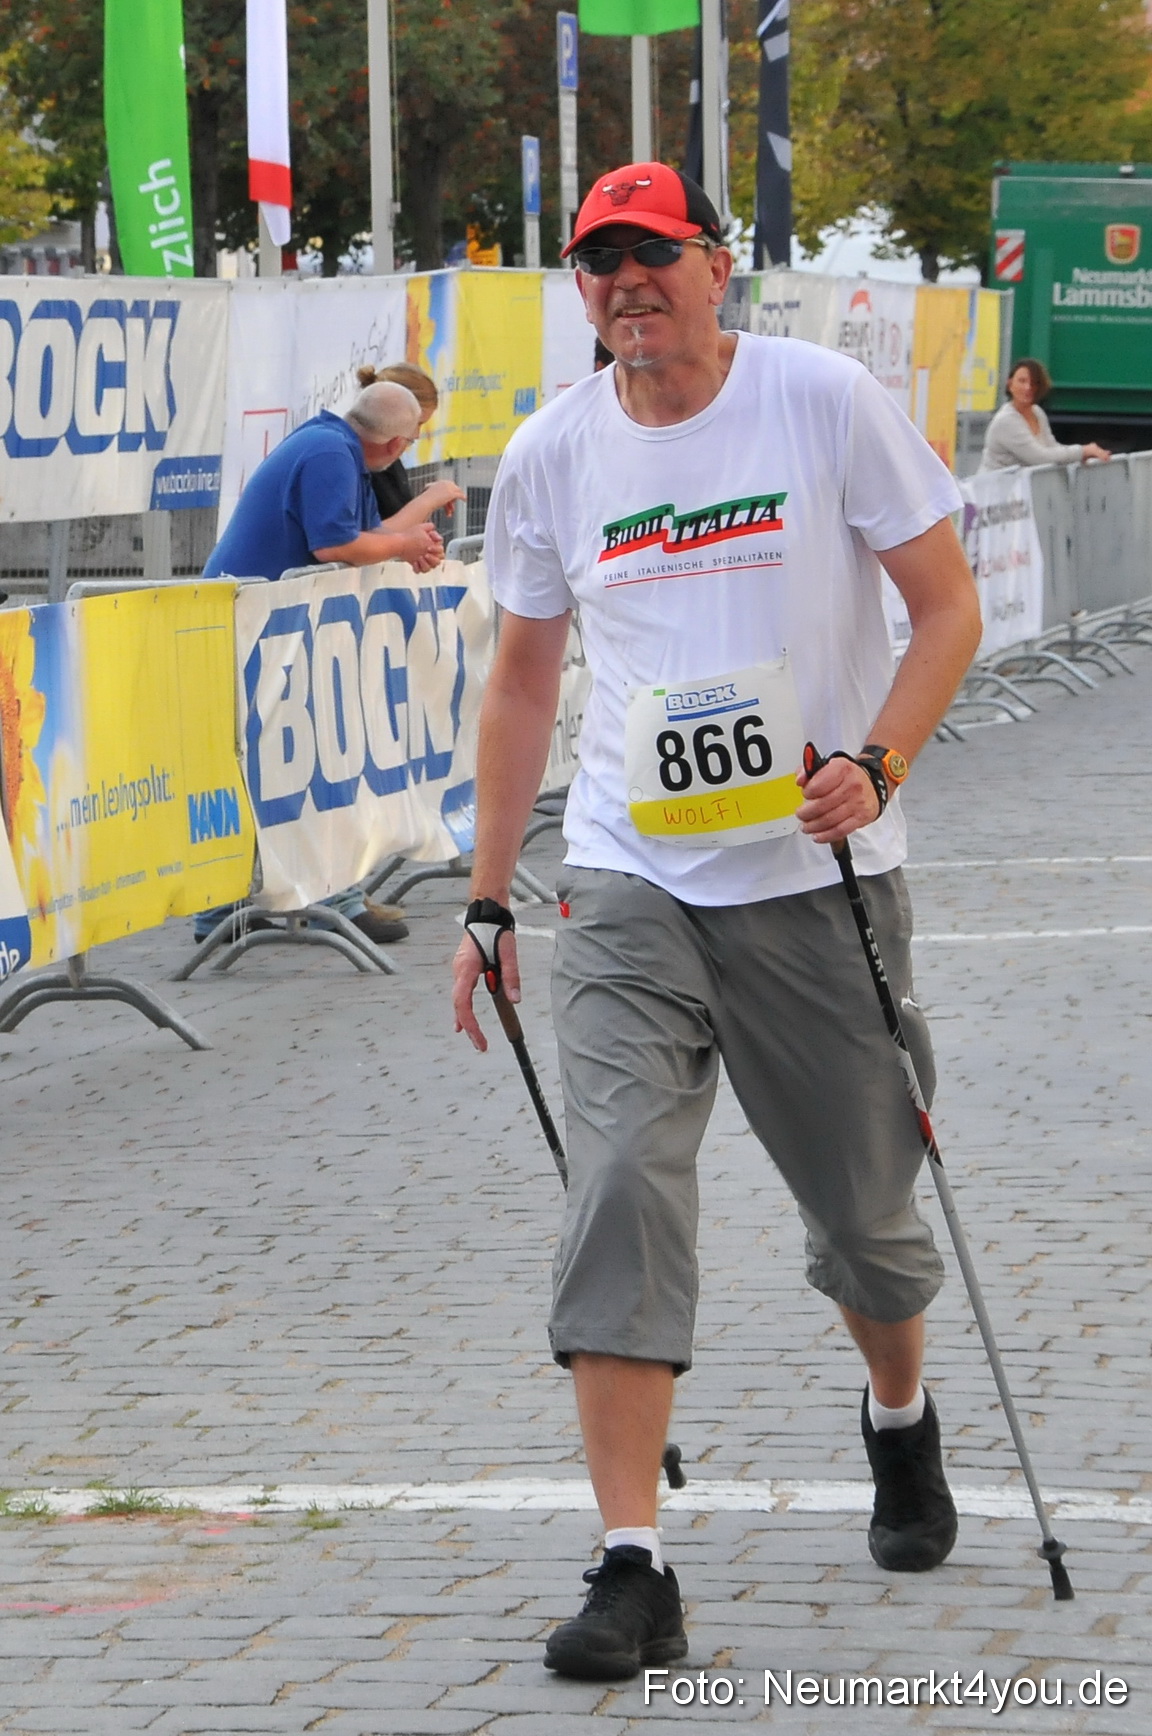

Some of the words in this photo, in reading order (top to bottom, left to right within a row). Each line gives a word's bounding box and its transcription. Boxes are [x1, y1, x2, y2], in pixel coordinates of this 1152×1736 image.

[138, 157, 195, 277] zlich
[0, 299, 181, 458] OCK
[674, 498, 778, 545] ITALIA
[604, 571, 629, 582] FEINE
[637, 560, 704, 576] ITALIENISCHE
[712, 551, 783, 567] SPEZIALITÄTEN
[245, 586, 467, 828] BOCK
[666, 683, 737, 711] BOCK
[656, 714, 773, 792] 866
